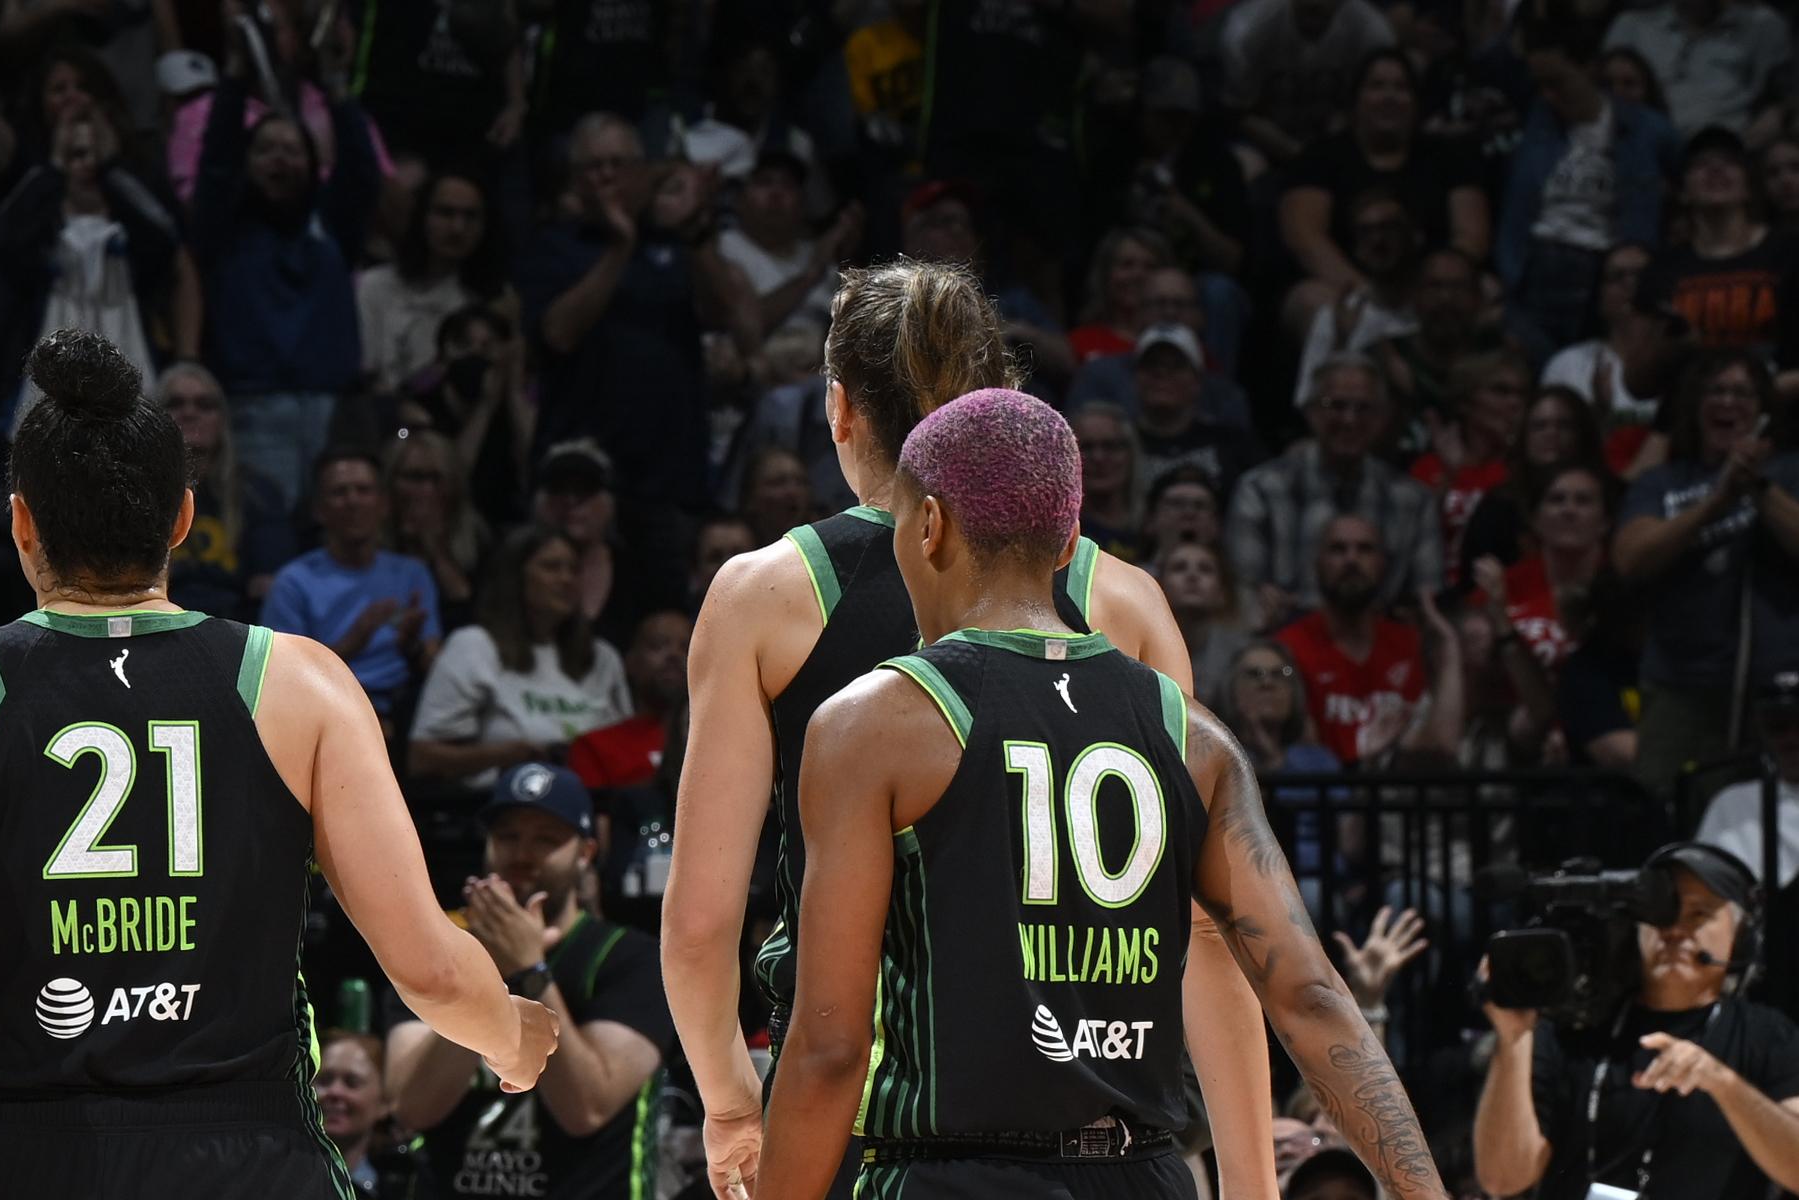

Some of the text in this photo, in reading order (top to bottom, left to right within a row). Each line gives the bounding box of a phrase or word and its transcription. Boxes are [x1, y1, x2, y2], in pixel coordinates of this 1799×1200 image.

[43, 720, 203, 879] 21
[1003, 740, 1166, 908] 10
[51, 896, 197, 954] McBRIDE
[1018, 922, 1159, 984] WILLIAMS
[101, 983, 200, 1025] AT&T
[1073, 1019, 1153, 1059] AT&T
[453, 1172, 549, 1198] CLINIC
[463, 1151, 542, 1174] MAYO
